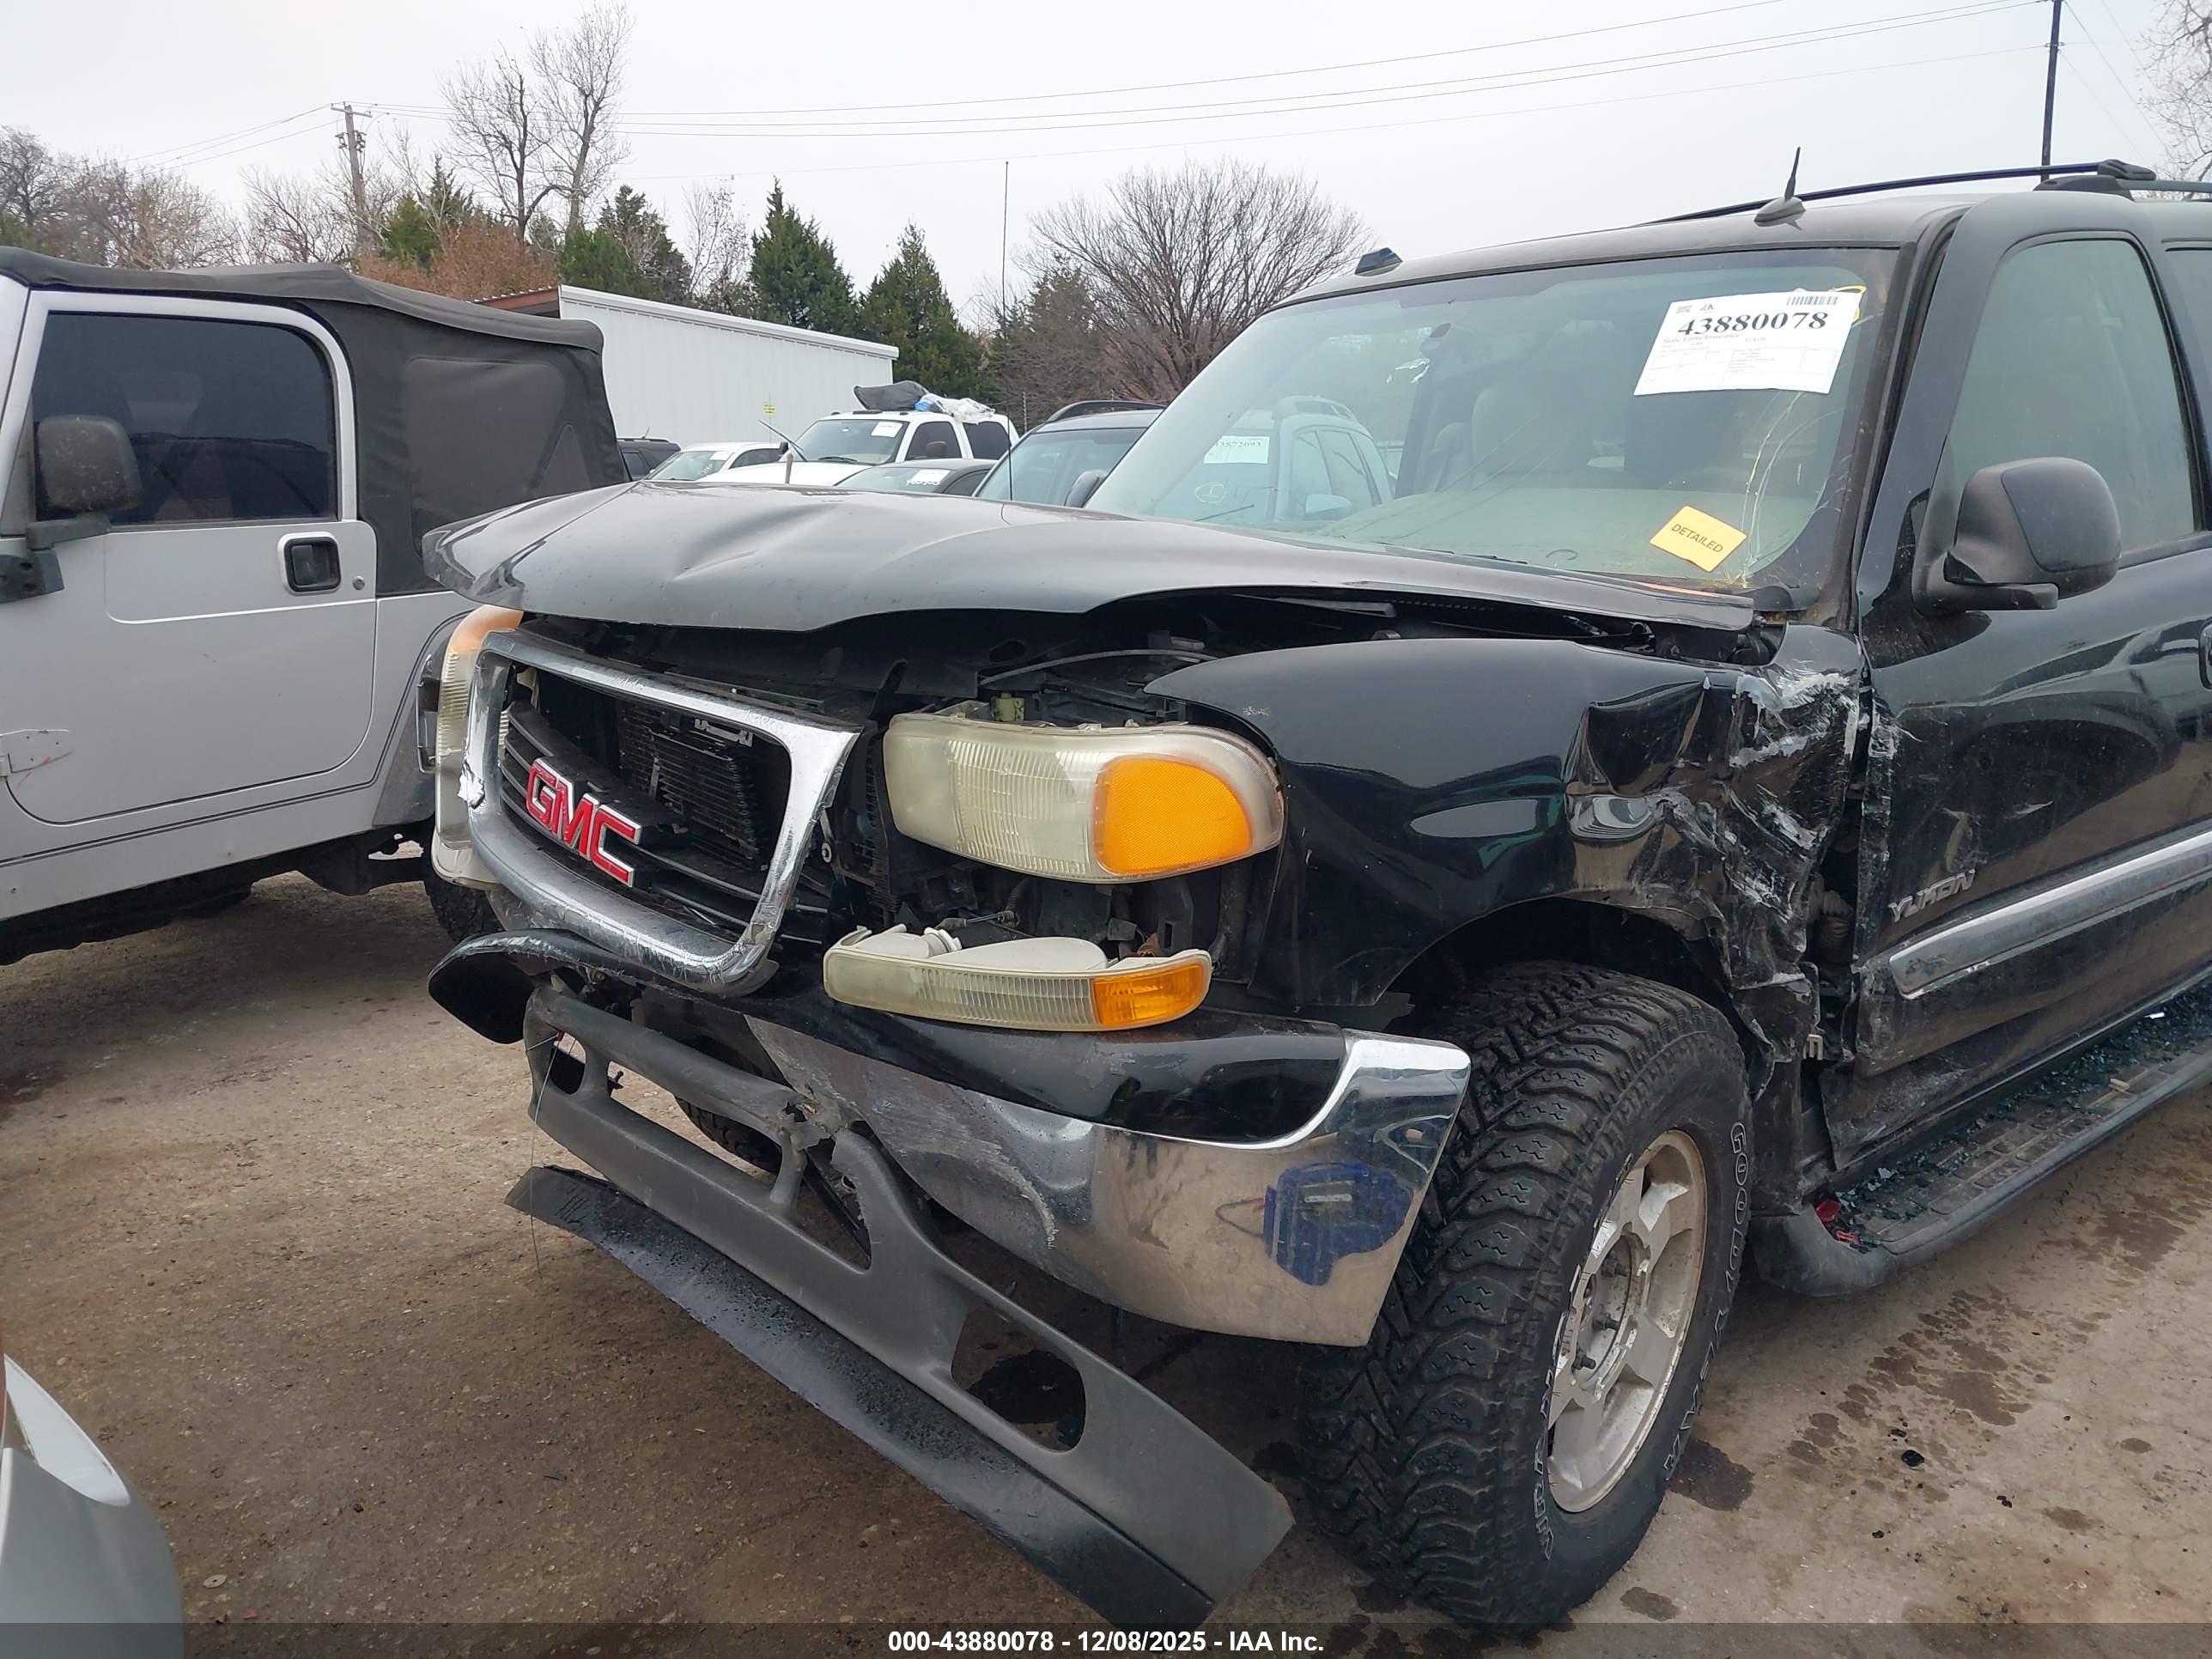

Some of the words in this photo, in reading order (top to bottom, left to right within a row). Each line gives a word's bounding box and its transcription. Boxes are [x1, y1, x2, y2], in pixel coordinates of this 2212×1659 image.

[1677, 312, 1829, 335] 43880078
[1671, 523, 1723, 553] DETAILED
[526, 758, 641, 888] GMC
